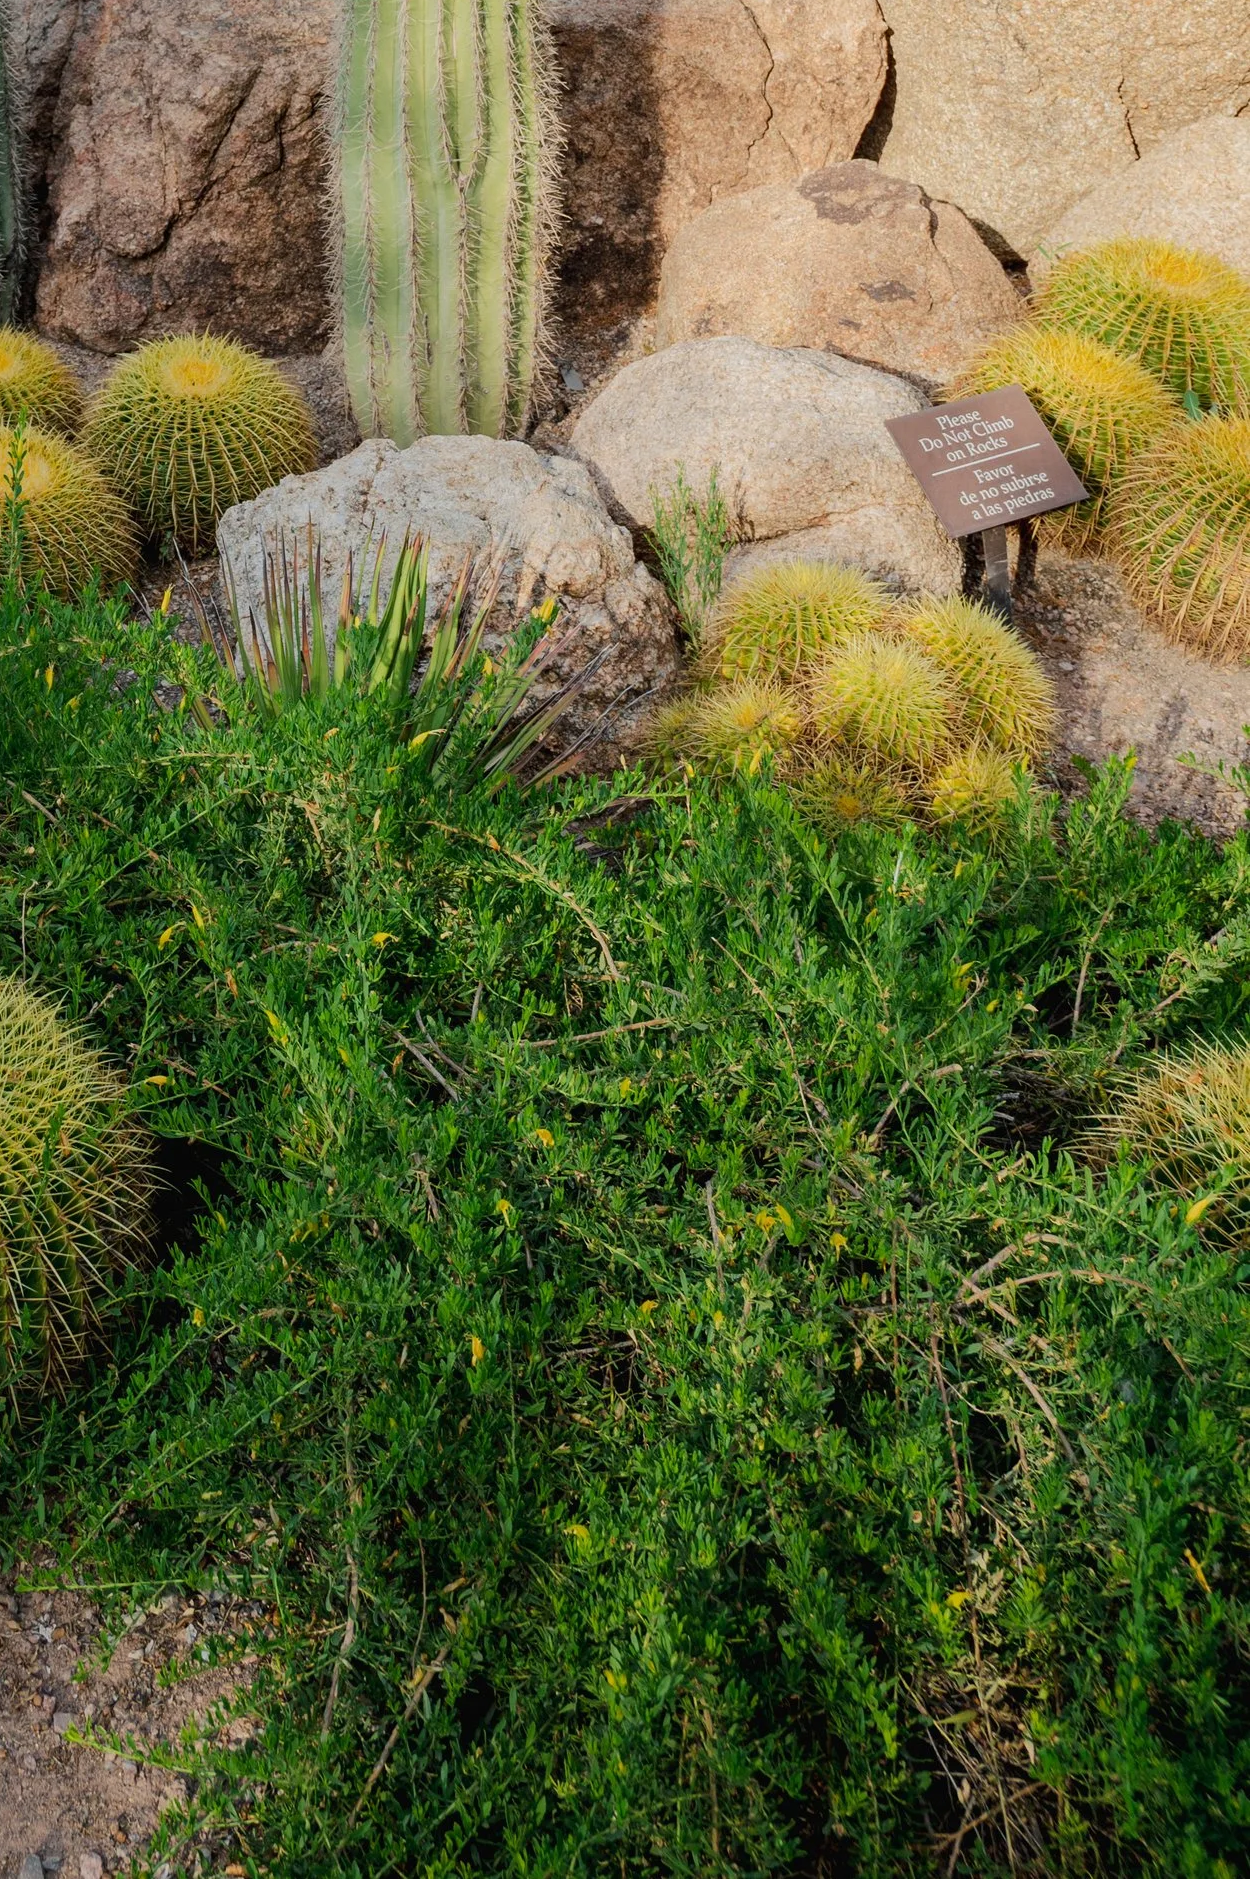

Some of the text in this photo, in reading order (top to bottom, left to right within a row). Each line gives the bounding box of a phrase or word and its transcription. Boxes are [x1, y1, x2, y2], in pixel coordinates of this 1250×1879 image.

[918, 416, 1014, 452] Do Not Climb
[936, 410, 982, 430] Please
[947, 436, 1008, 462] on Rocks
[960, 471, 1049, 506] de no subirse
[973, 464, 1014, 484] Favor
[971, 486, 1055, 520] a las piedras
